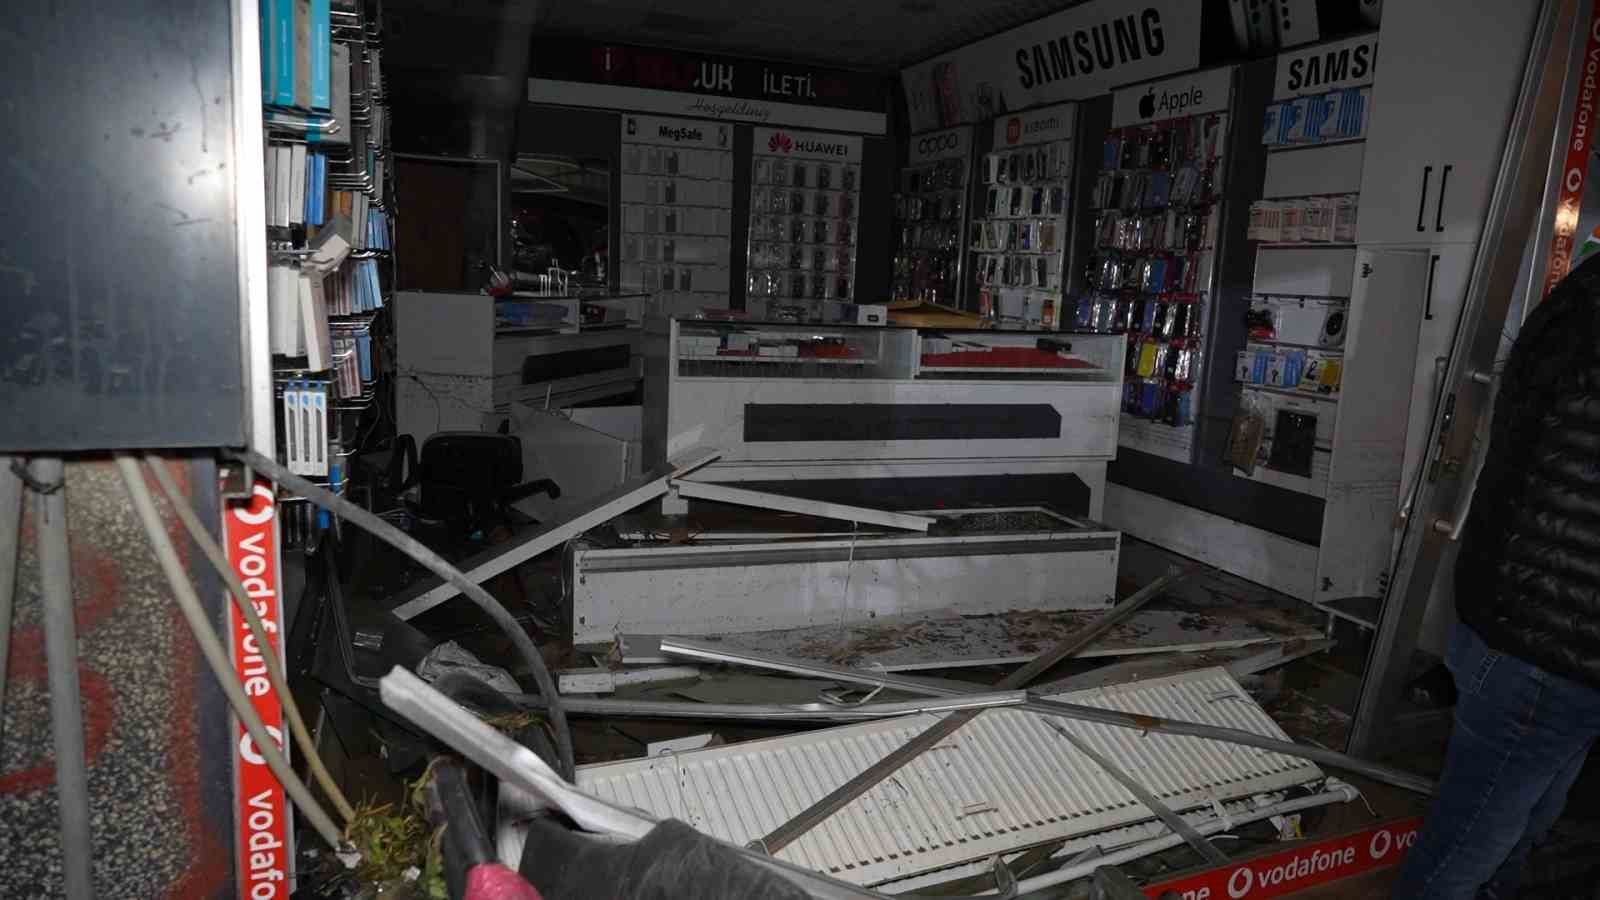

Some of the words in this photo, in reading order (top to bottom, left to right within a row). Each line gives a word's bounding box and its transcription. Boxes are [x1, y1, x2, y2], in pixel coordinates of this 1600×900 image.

[1016, 8, 1165, 89] SAMSUNG
[1287, 42, 1377, 91] SAMS
[1159, 86, 1203, 113] Apple
[1574, 48, 1600, 152] vodafone
[795, 143, 848, 156] HUAWEI
[1259, 845, 1355, 889] vodafone
